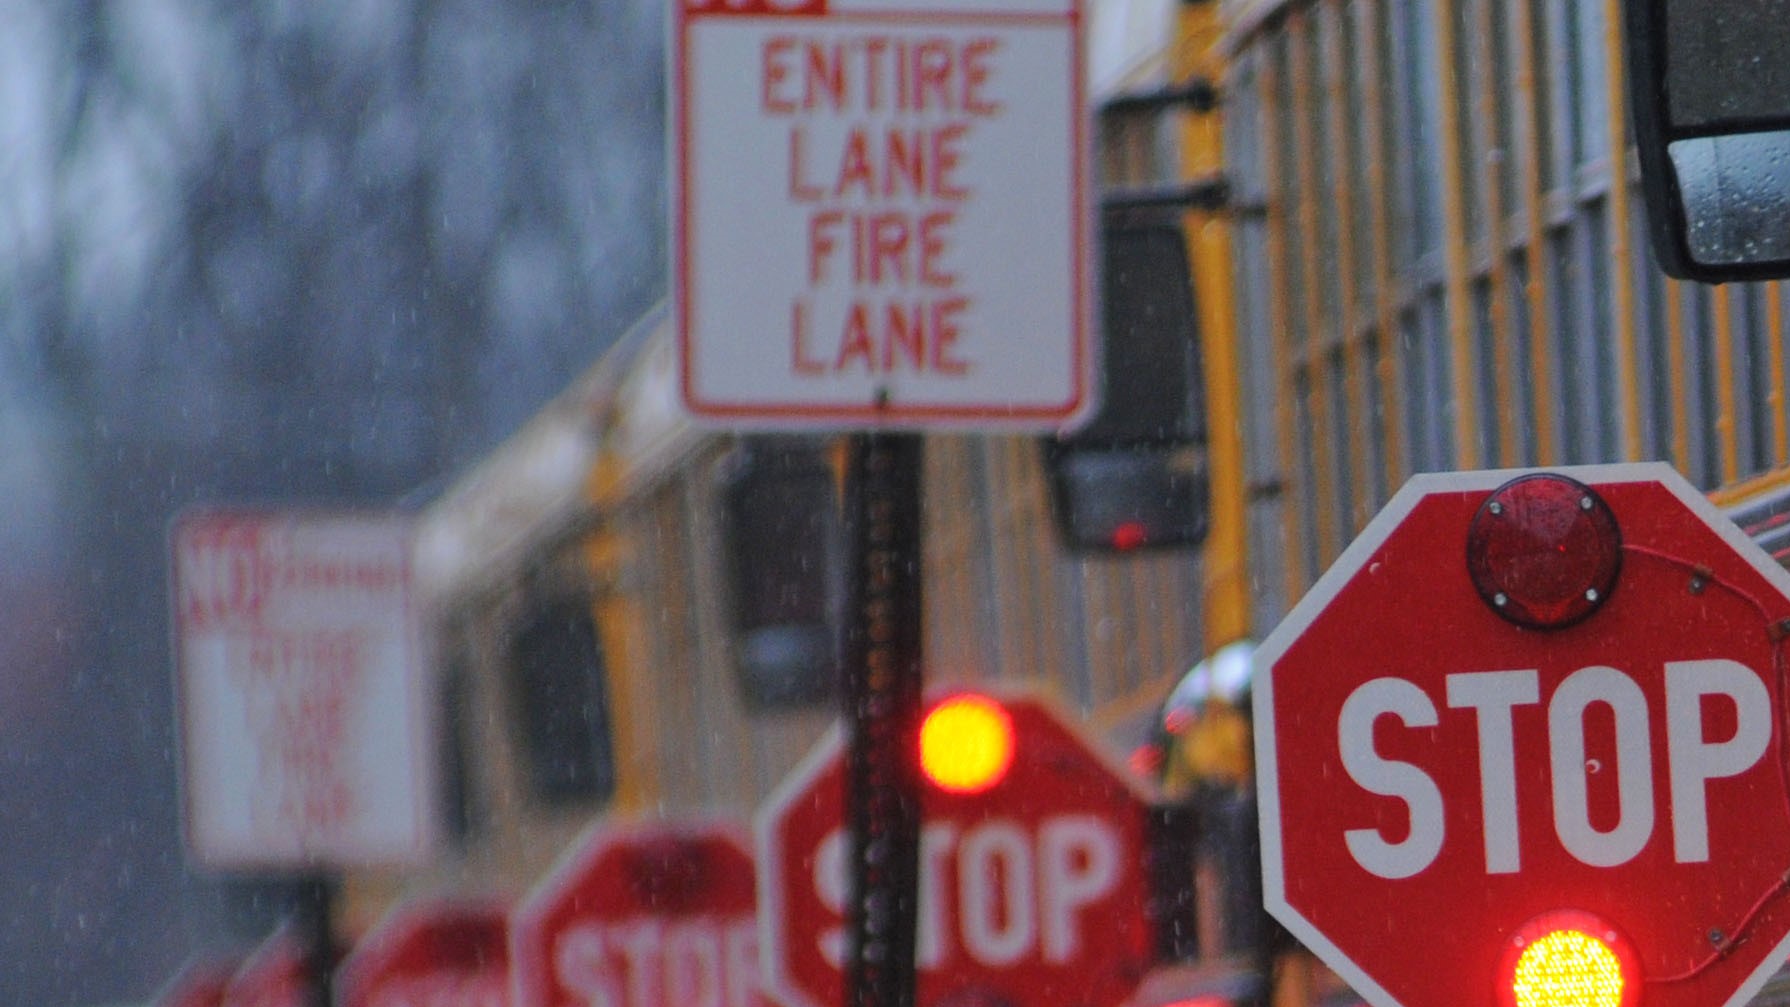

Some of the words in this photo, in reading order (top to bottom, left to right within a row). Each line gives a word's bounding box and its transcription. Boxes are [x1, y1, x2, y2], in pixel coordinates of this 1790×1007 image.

[761, 37, 1003, 116] ENTIRE
[790, 124, 972, 201] LANE
[809, 211, 958, 288] FIRE
[791, 298, 972, 378] LANE
[1338, 658, 1772, 880] STOP
